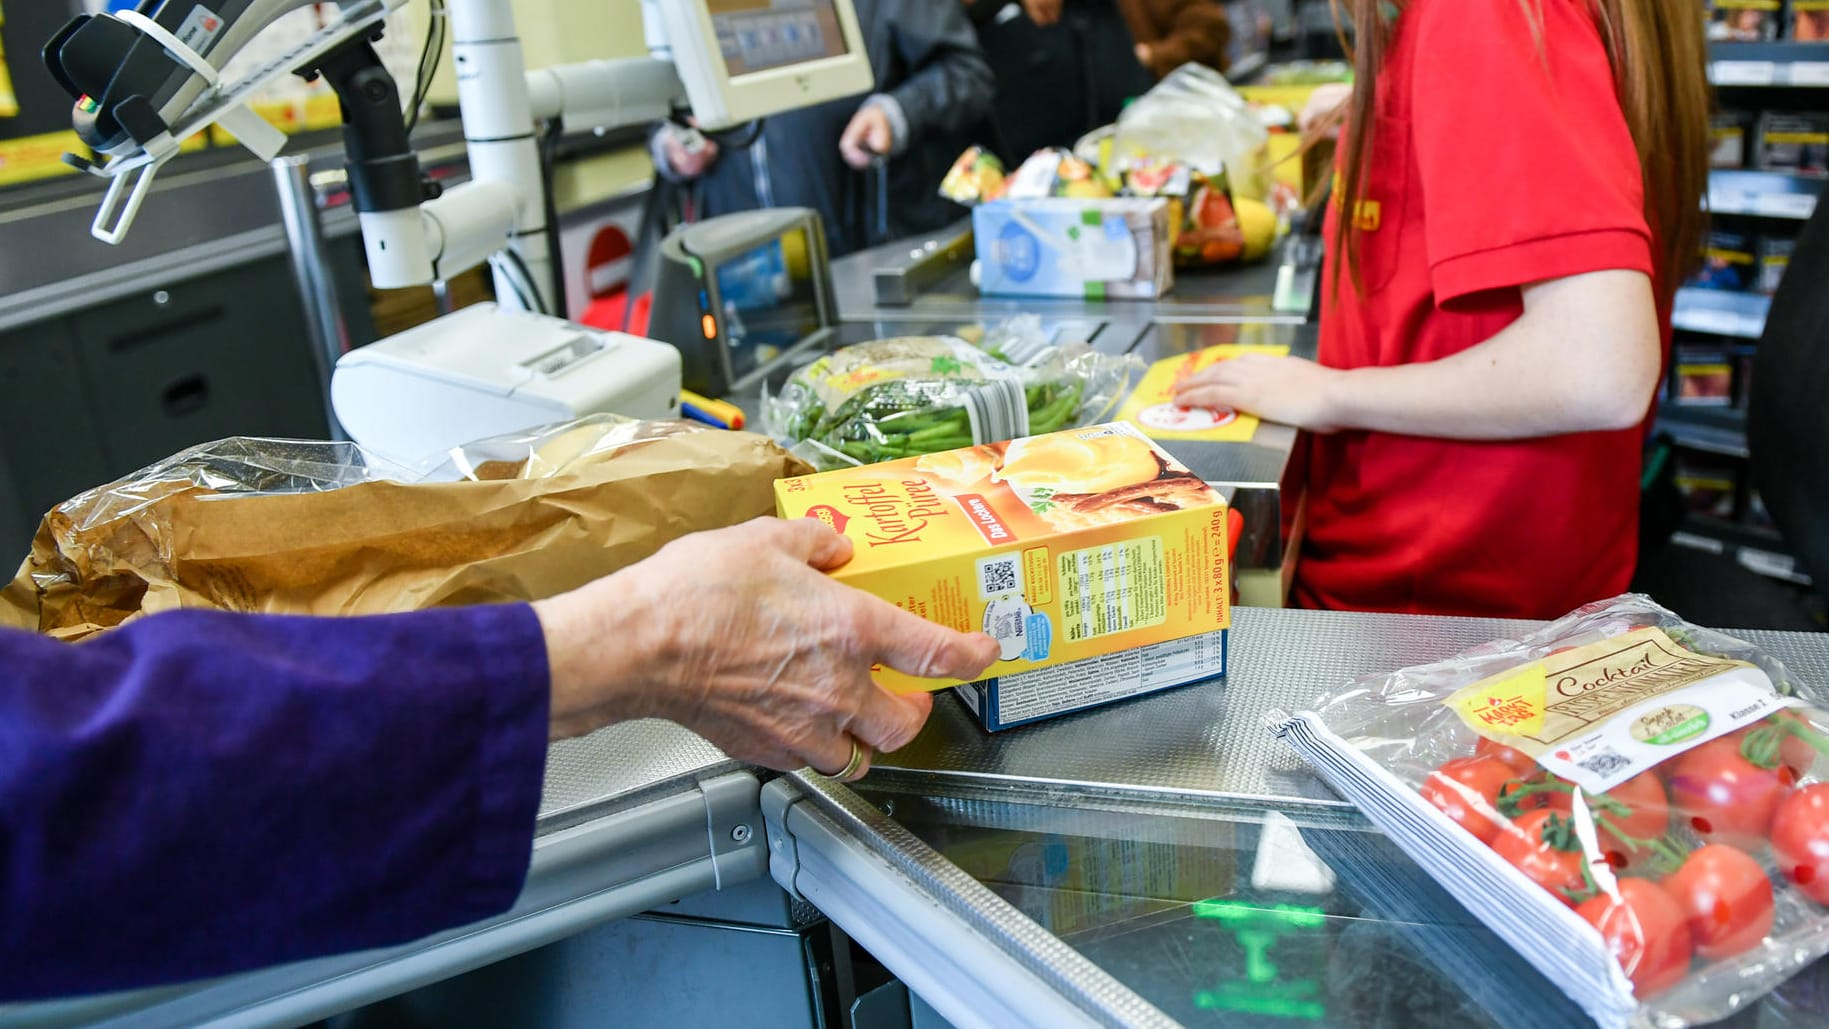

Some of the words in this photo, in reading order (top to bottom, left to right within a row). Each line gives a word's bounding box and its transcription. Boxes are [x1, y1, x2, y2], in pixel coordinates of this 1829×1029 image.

[843, 483, 928, 548] Kartoffel
[901, 478, 950, 519] Püree
[967, 498, 999, 526] Lockere
[985, 522, 1009, 539] Das
[1556, 653, 1660, 697] Cocktail
